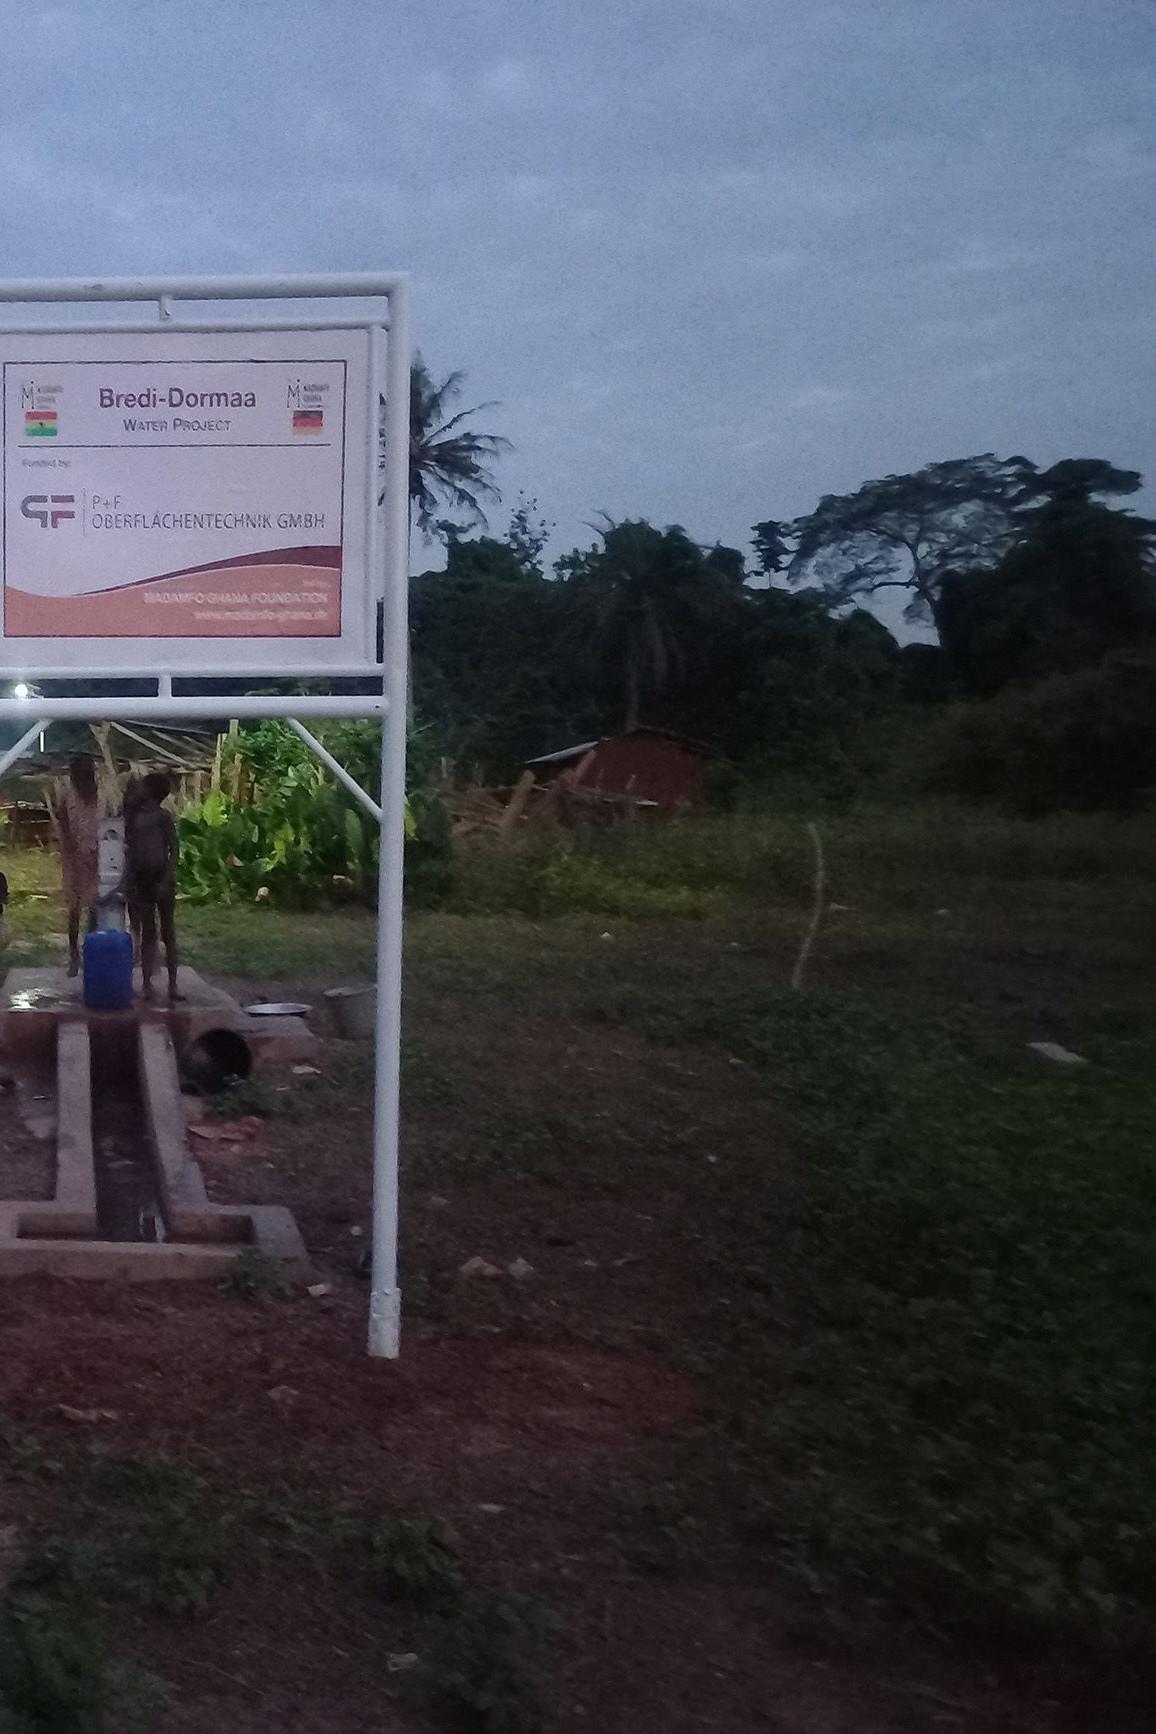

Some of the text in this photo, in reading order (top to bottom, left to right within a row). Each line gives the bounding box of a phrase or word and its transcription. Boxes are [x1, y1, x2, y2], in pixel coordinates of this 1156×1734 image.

[99, 387, 257, 408] Bredi-Dormaa
[122, 417, 232, 431] WATER PROJECT
[277, 513, 325, 529] GMBH
